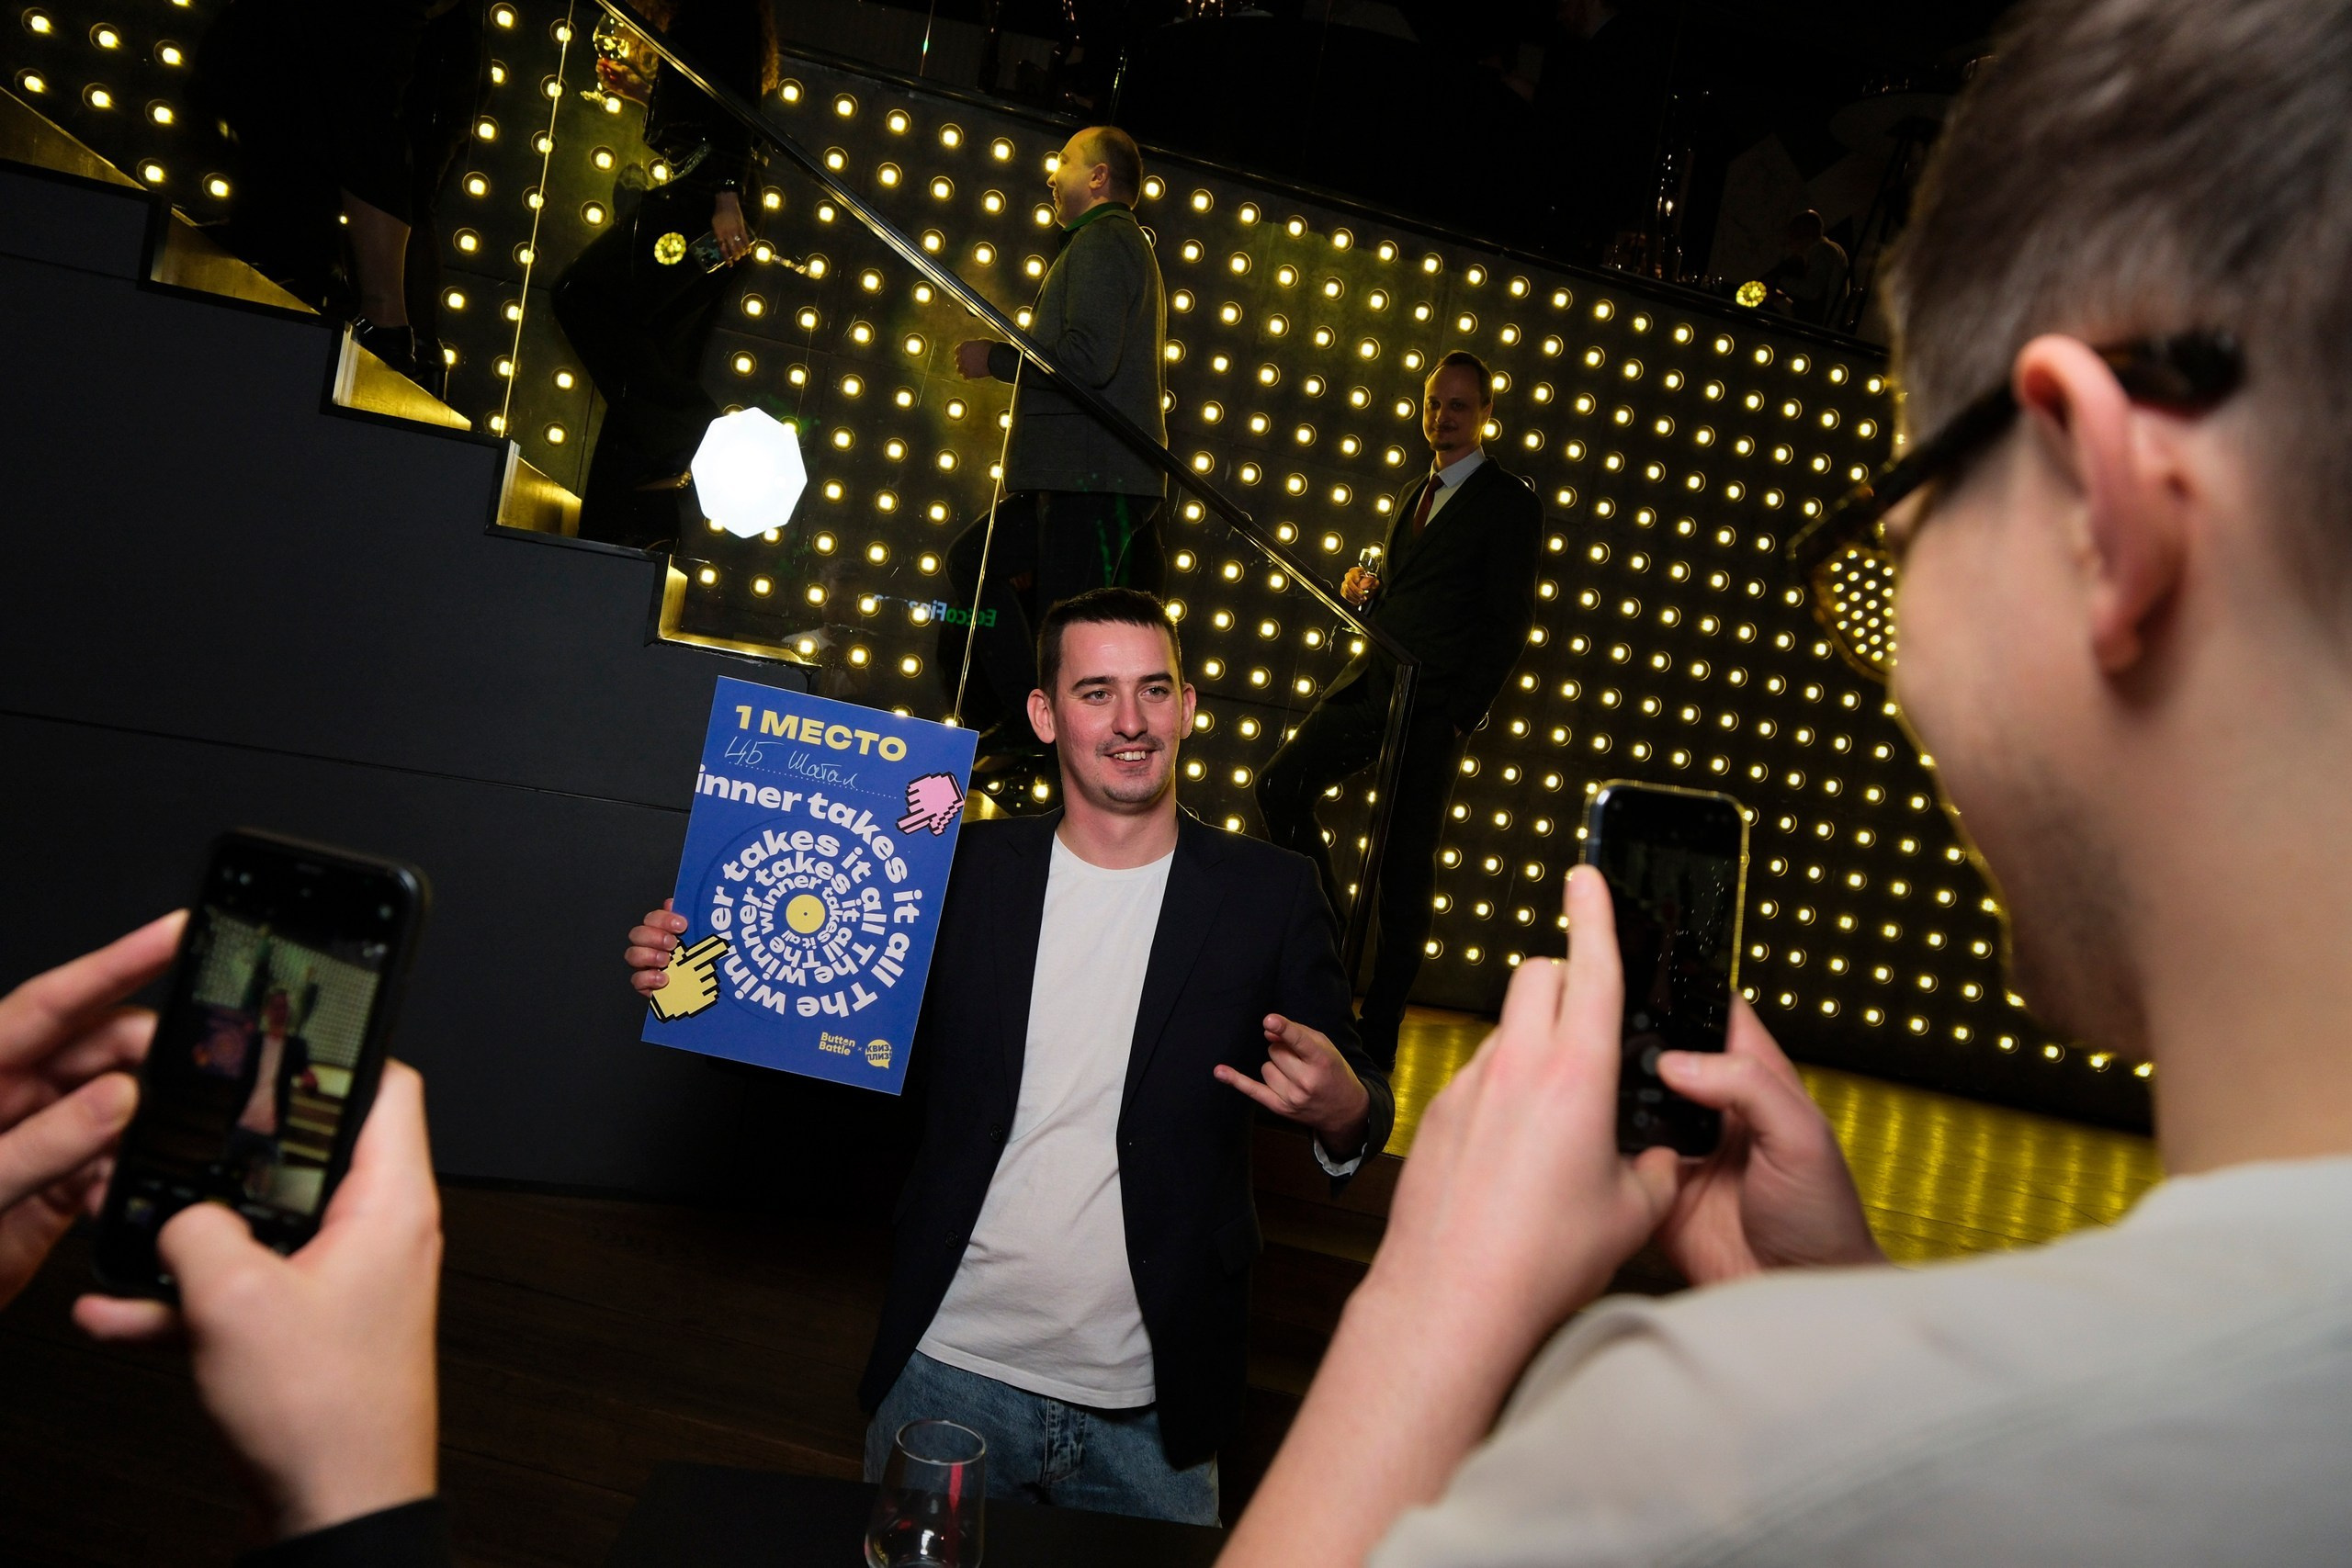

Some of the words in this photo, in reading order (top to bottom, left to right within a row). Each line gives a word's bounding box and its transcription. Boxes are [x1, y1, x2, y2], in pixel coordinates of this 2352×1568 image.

[735, 705, 752, 730] 1
[759, 709, 908, 761] МЕСТО
[722, 829, 841, 882] takes
[807, 792, 909, 884] takes
[754, 851, 851, 895] takes
[841, 846, 872, 884] it
[759, 874, 823, 935] winner
[817, 886, 843, 943] takes
[842, 898, 862, 923] it
[861, 886, 888, 936] all
[893, 889, 923, 924] it
[739, 886, 807, 987] winner
[769, 936, 821, 969] The
[781, 930, 801, 944] all
[802, 937, 817, 950] it
[821, 927, 853, 964] all
[814, 942, 877, 984] The
[870, 932, 910, 988] all
[796, 981, 878, 1018] The
[819, 1041, 851, 1055] Battle
[820, 1032, 856, 1047] Button
